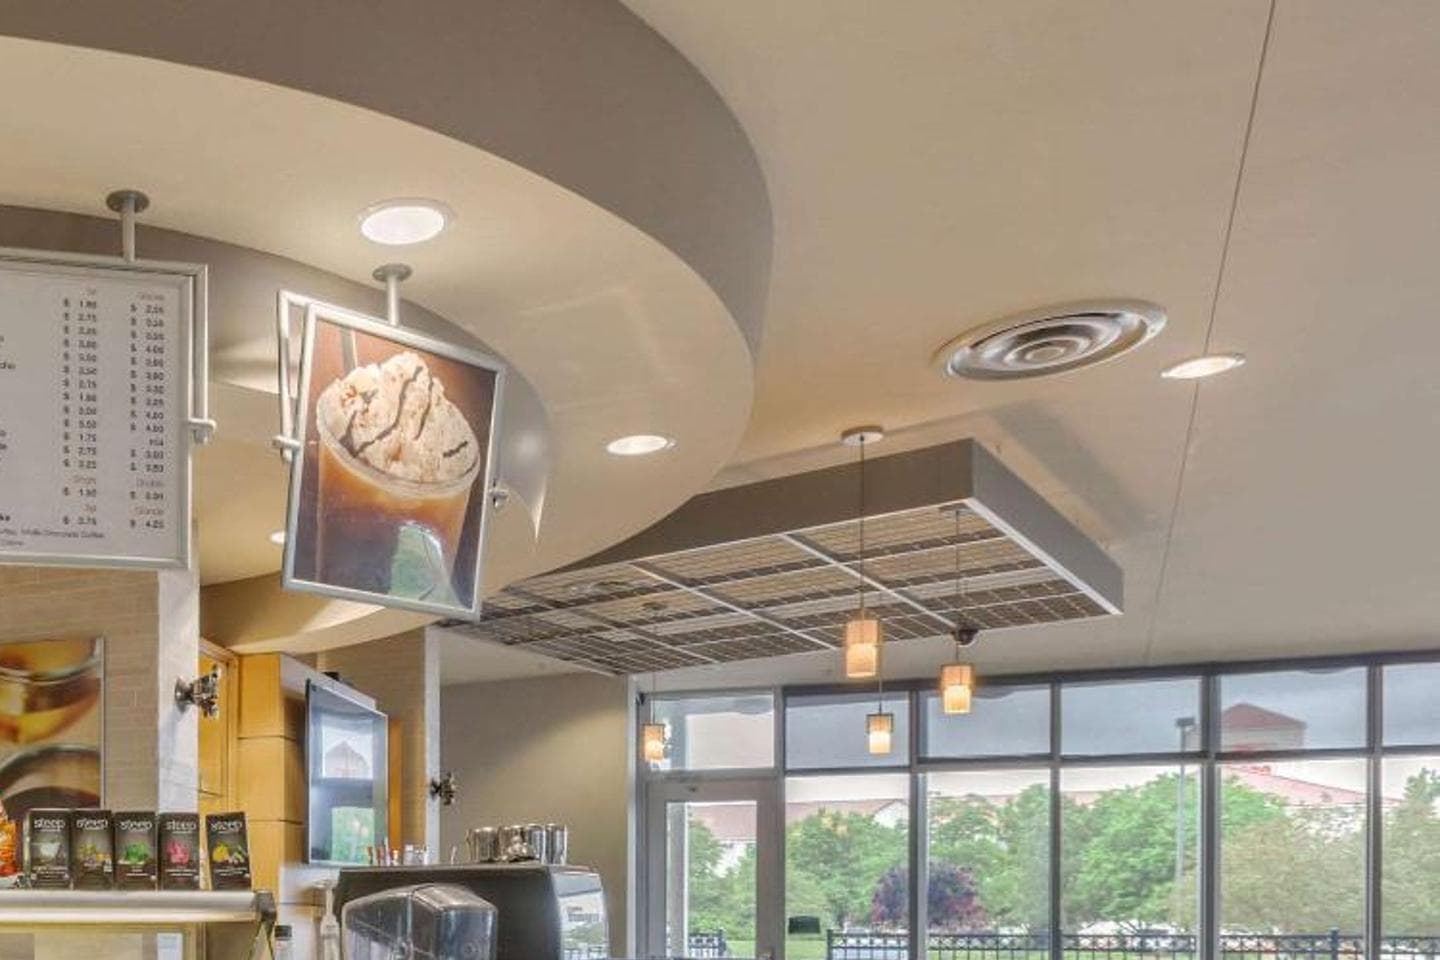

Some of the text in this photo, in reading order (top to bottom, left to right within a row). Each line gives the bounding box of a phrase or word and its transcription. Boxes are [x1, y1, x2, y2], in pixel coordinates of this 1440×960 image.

[34, 818, 66, 832] steep
[120, 819, 153, 832] steep
[166, 819, 197, 831] steep
[211, 820, 243, 832] steep
